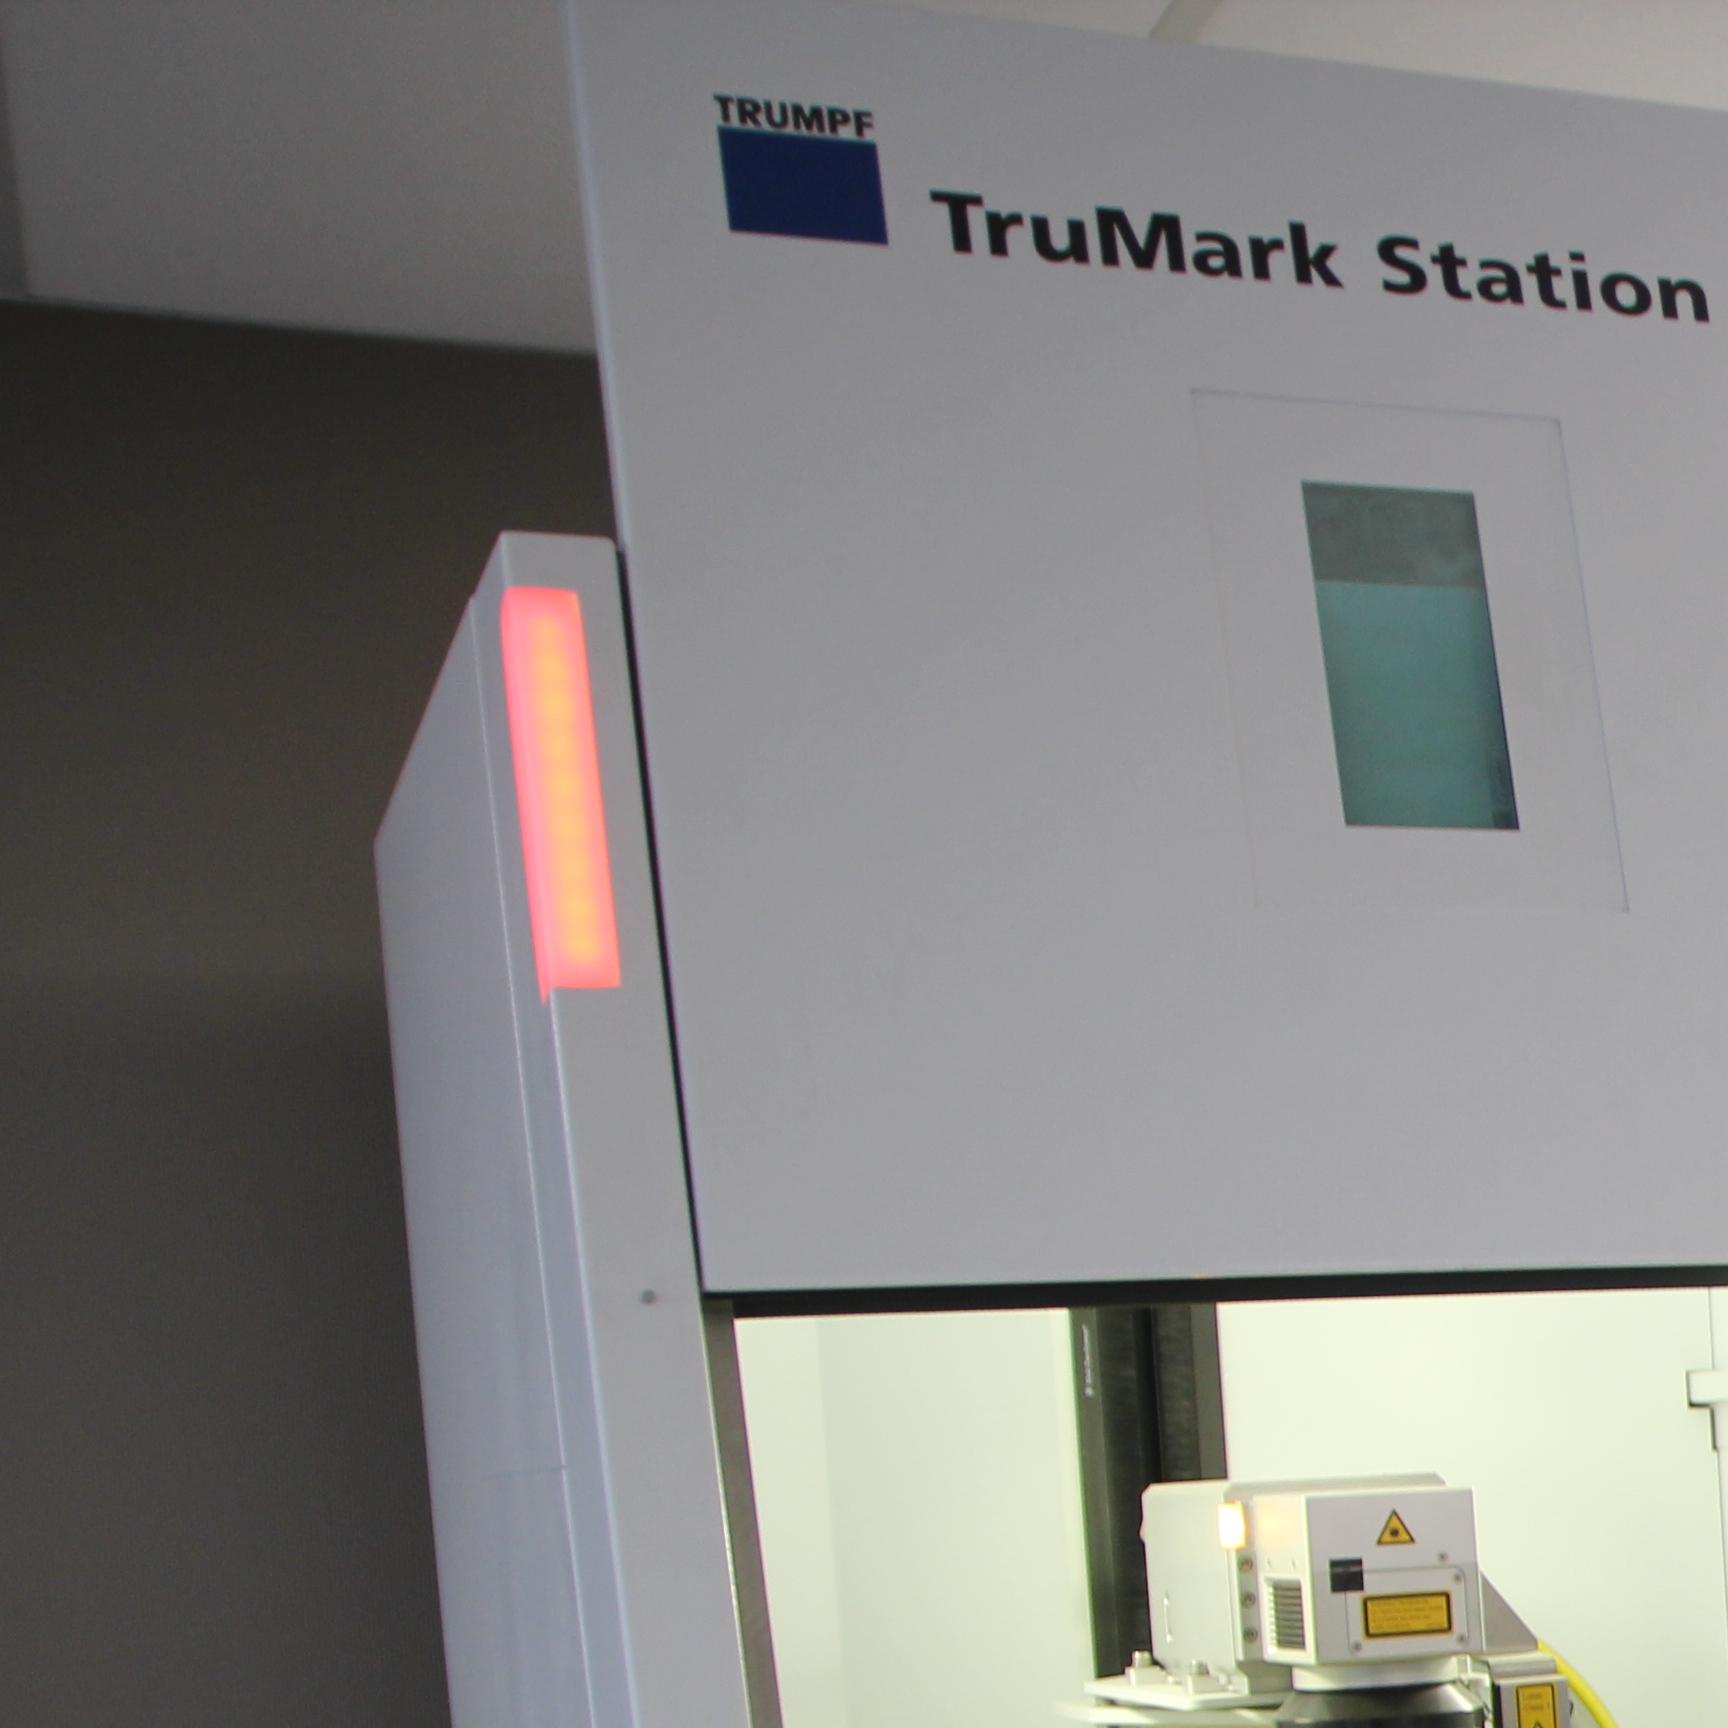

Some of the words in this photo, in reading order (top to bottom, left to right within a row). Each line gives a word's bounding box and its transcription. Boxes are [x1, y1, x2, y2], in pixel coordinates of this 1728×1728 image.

[713, 94, 875, 139] TRUMPF
[929, 190, 1343, 288] TruMark
[1376, 235, 1710, 323] Station
